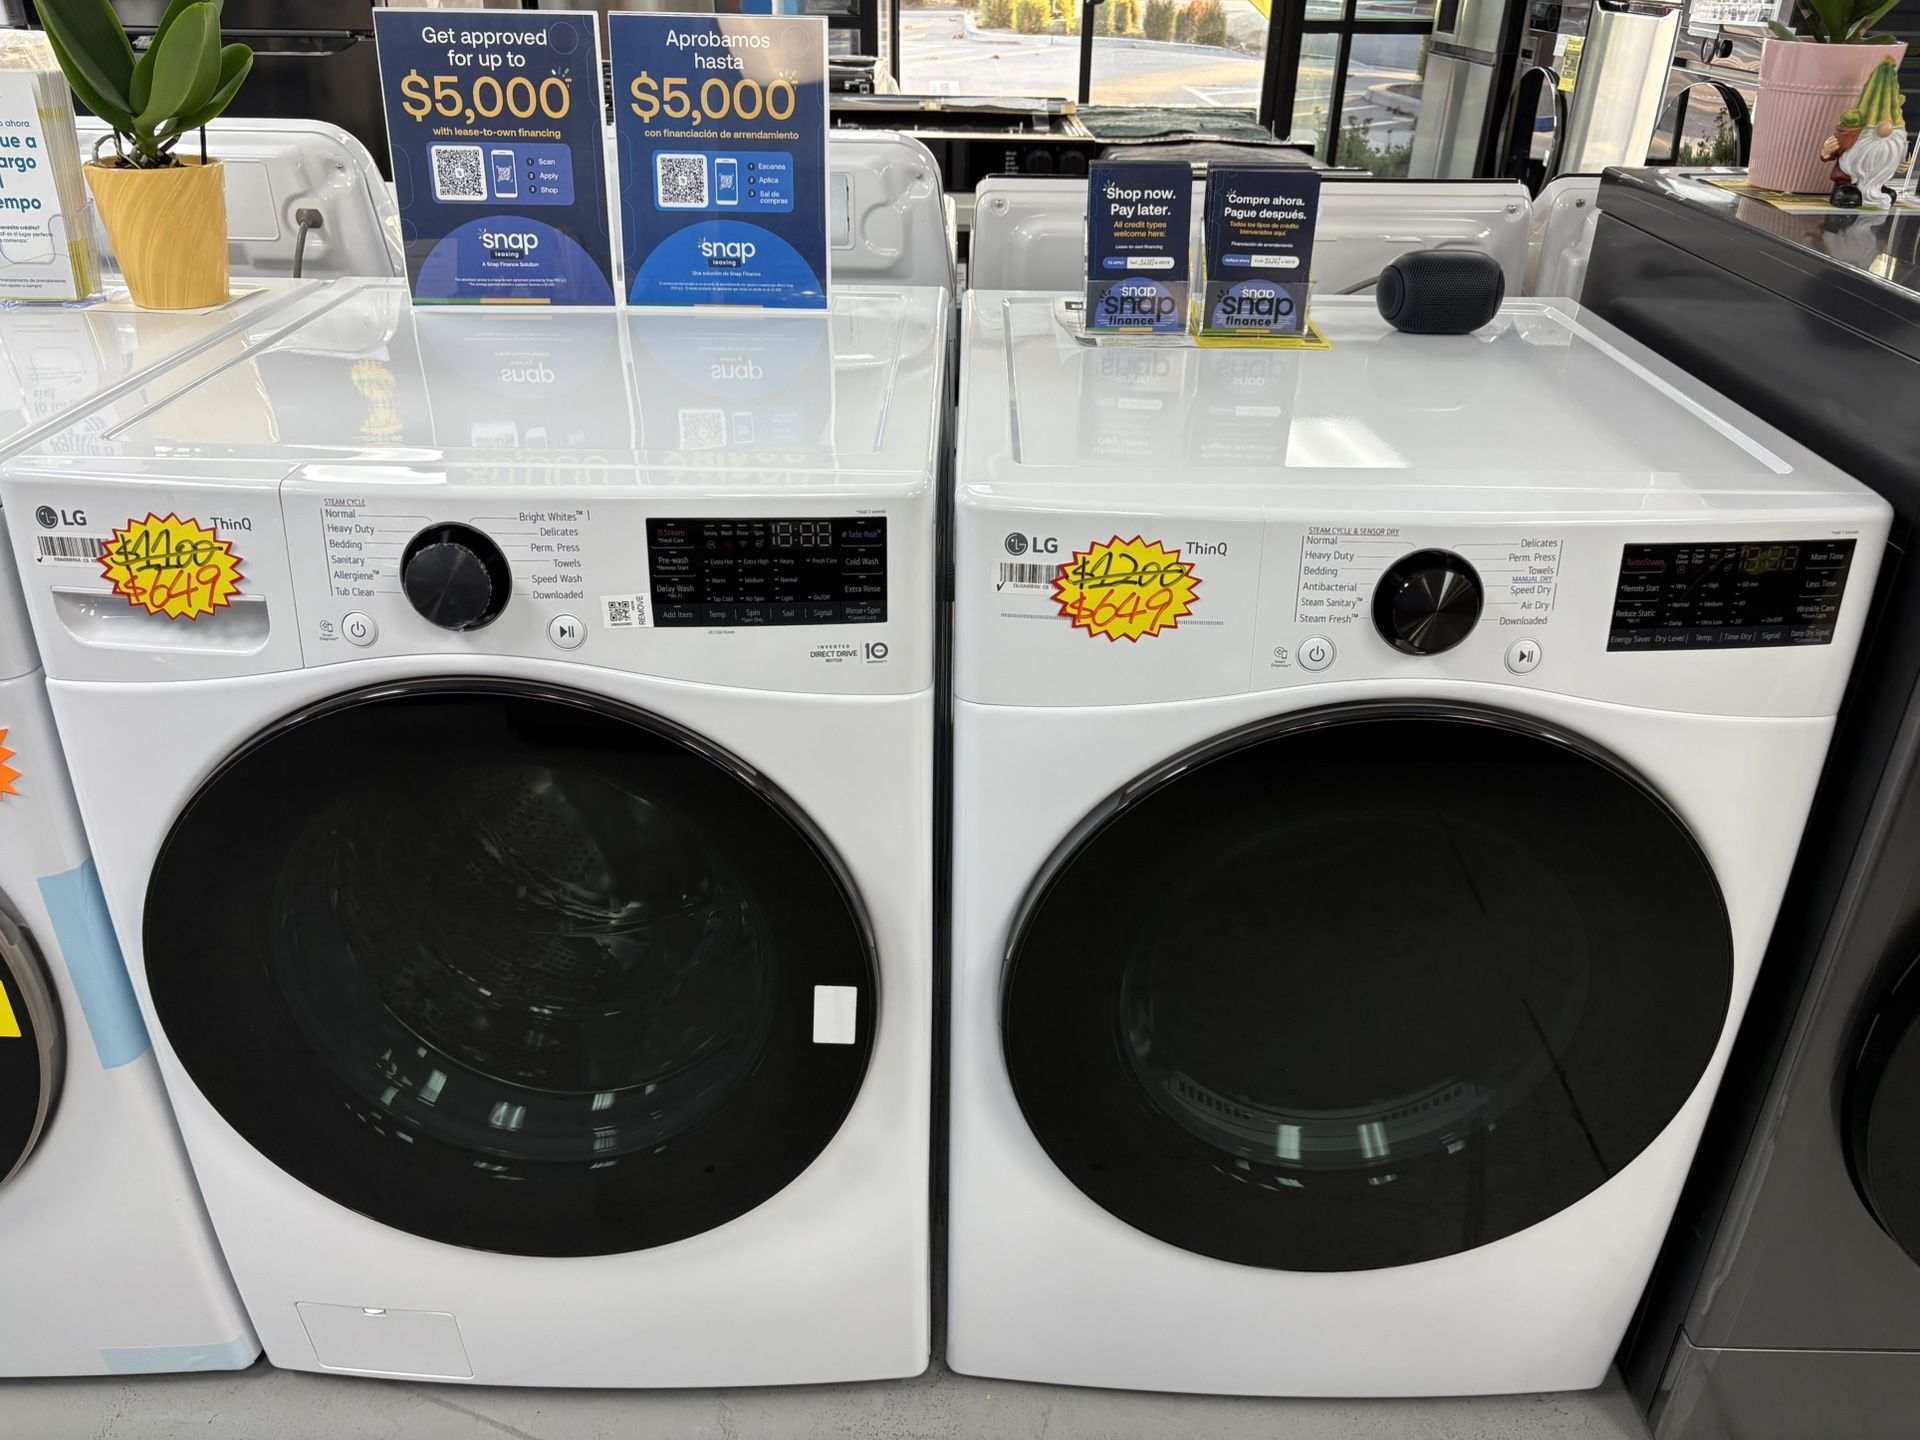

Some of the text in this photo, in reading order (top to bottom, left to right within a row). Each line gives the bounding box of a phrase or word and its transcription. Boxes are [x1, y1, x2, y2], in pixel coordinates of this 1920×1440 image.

[421, 26, 548, 49] Get approved
[665, 30, 771, 50] Aprobamos
[447, 49, 526, 71] for up to
[694, 52, 745, 70] hasta
[401, 69, 571, 125] $5,000
[630, 70, 796, 126] $5,000
[5, 120, 30, 128] ahora
[433, 126, 561, 139] with lease-to-own financing
[644, 129, 799, 140] con financiación de arrendamiento
[25, 137, 37, 148] a
[538, 158, 556, 166] Scan
[539, 172, 558, 181] Apply
[758, 176, 779, 185] Aplica
[540, 186, 558, 195] Shop
[760, 190, 780, 198] Sal de
[1106, 187, 1176, 202] Shop now.
[760, 198, 788, 206] compras
[1228, 194, 1305, 206] Compre ahora.
[1110, 203, 1171, 218] Pay later.
[1224, 207, 1307, 221] Pague después.
[1146, 221, 1167, 230] types
[1256, 222, 1270, 230] tipos
[482, 232, 539, 256] snap
[494, 250, 520, 258] leasing
[701, 241, 756, 264] snap
[712, 258, 737, 267] leasing
[1121, 286, 1157, 297] snap
[1104, 296, 1176, 322] snap
[1221, 296, 1294, 323] snap
[1109, 315, 1154, 326] finance
[1225, 316, 1271, 326] finance
[346, 499, 366, 507] CYCLE
[61, 510, 87, 526] LG
[325, 509, 356, 518] Normal
[519, 512, 545, 523] Bright
[210, 517, 252, 532] ThinQ
[327, 524, 375, 536] Heavy Duty
[540, 527, 579, 537] Delicates
[1386, 528, 1400, 536] DRY
[329, 539, 363, 551] Bedding
[1032, 537, 1058, 554] LG
[1306, 536, 1338, 545] Normal
[1521, 539, 1558, 548] Delicates
[530, 543, 580, 553] Perm. Press
[1186, 541, 1228, 557] ThinQ
[658, 556, 689, 565] Pre-wash
[1304, 550, 1355, 562] Heavy Duty
[1508, 553, 1556, 562] Perm. Press
[331, 556, 365, 567] Sanitary
[553, 558, 581, 568] Towels
[1303, 566, 1338, 577] Bedding
[1528, 566, 1554, 575] Towels
[531, 574, 583, 585] Speed Wash
[1539, 575, 1553, 583] DRY
[1805, 580, 1837, 588] Less Time
[116, 564, 221, 609] $649
[656, 585, 675, 593] Delay
[844, 585, 862, 593] Extra
[1302, 582, 1357, 592] Antibacterial
[1510, 585, 1552, 596] Speed Dry
[1645, 584, 1660, 592] Start
[335, 587, 375, 597] Tub Clean
[532, 590, 584, 600] Downloaded
[1301, 597, 1325, 607] Steam
[1520, 601, 1550, 611] Air Dry
[636, 595, 647, 625] REMOVE
[745, 609, 760, 617] Spin
[782, 609, 795, 617] Soil
[812, 609, 833, 618] Signal
[1068, 588, 1174, 631] $649
[1615, 610, 1637, 618] Reduce
[662, 611, 676, 619] Add
[1299, 614, 1327, 623] Steam
[1499, 616, 1548, 625] Downloaded
[1610, 636, 1632, 644] Energy
[1655, 634, 1685, 643] Dry Level
[1739, 633, 1752, 641] Dry
[1761, 632, 1781, 640] Signal
[810, 650, 836, 658] DIRECT
[865, 641, 889, 660] 10
